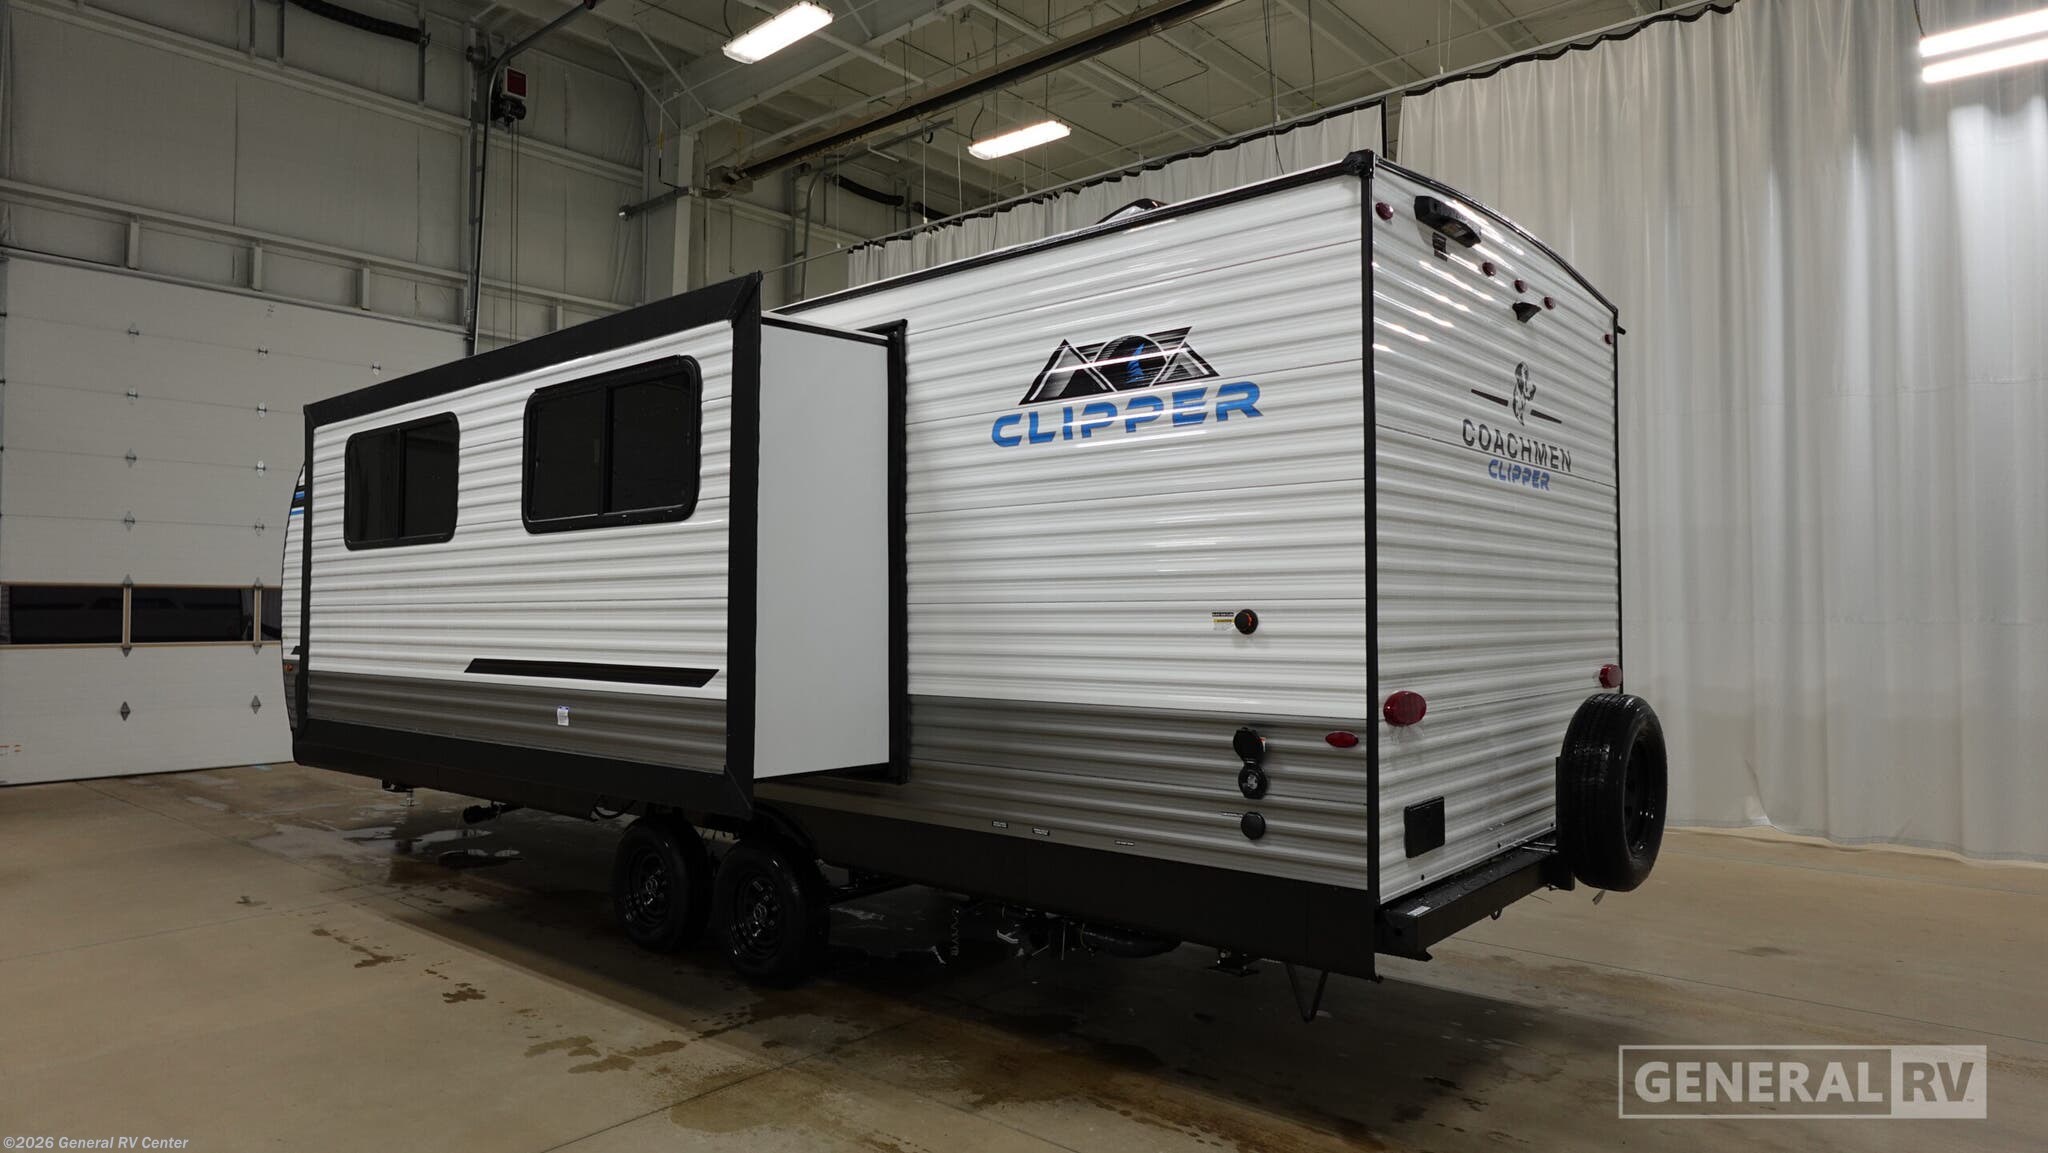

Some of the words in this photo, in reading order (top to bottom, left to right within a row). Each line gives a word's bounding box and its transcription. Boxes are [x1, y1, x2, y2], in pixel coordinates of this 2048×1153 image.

[991, 380, 1264, 448] CLIPPER
[1462, 418, 1572, 473] COACHMEN
[1488, 458, 1551, 491] CLIPPER
